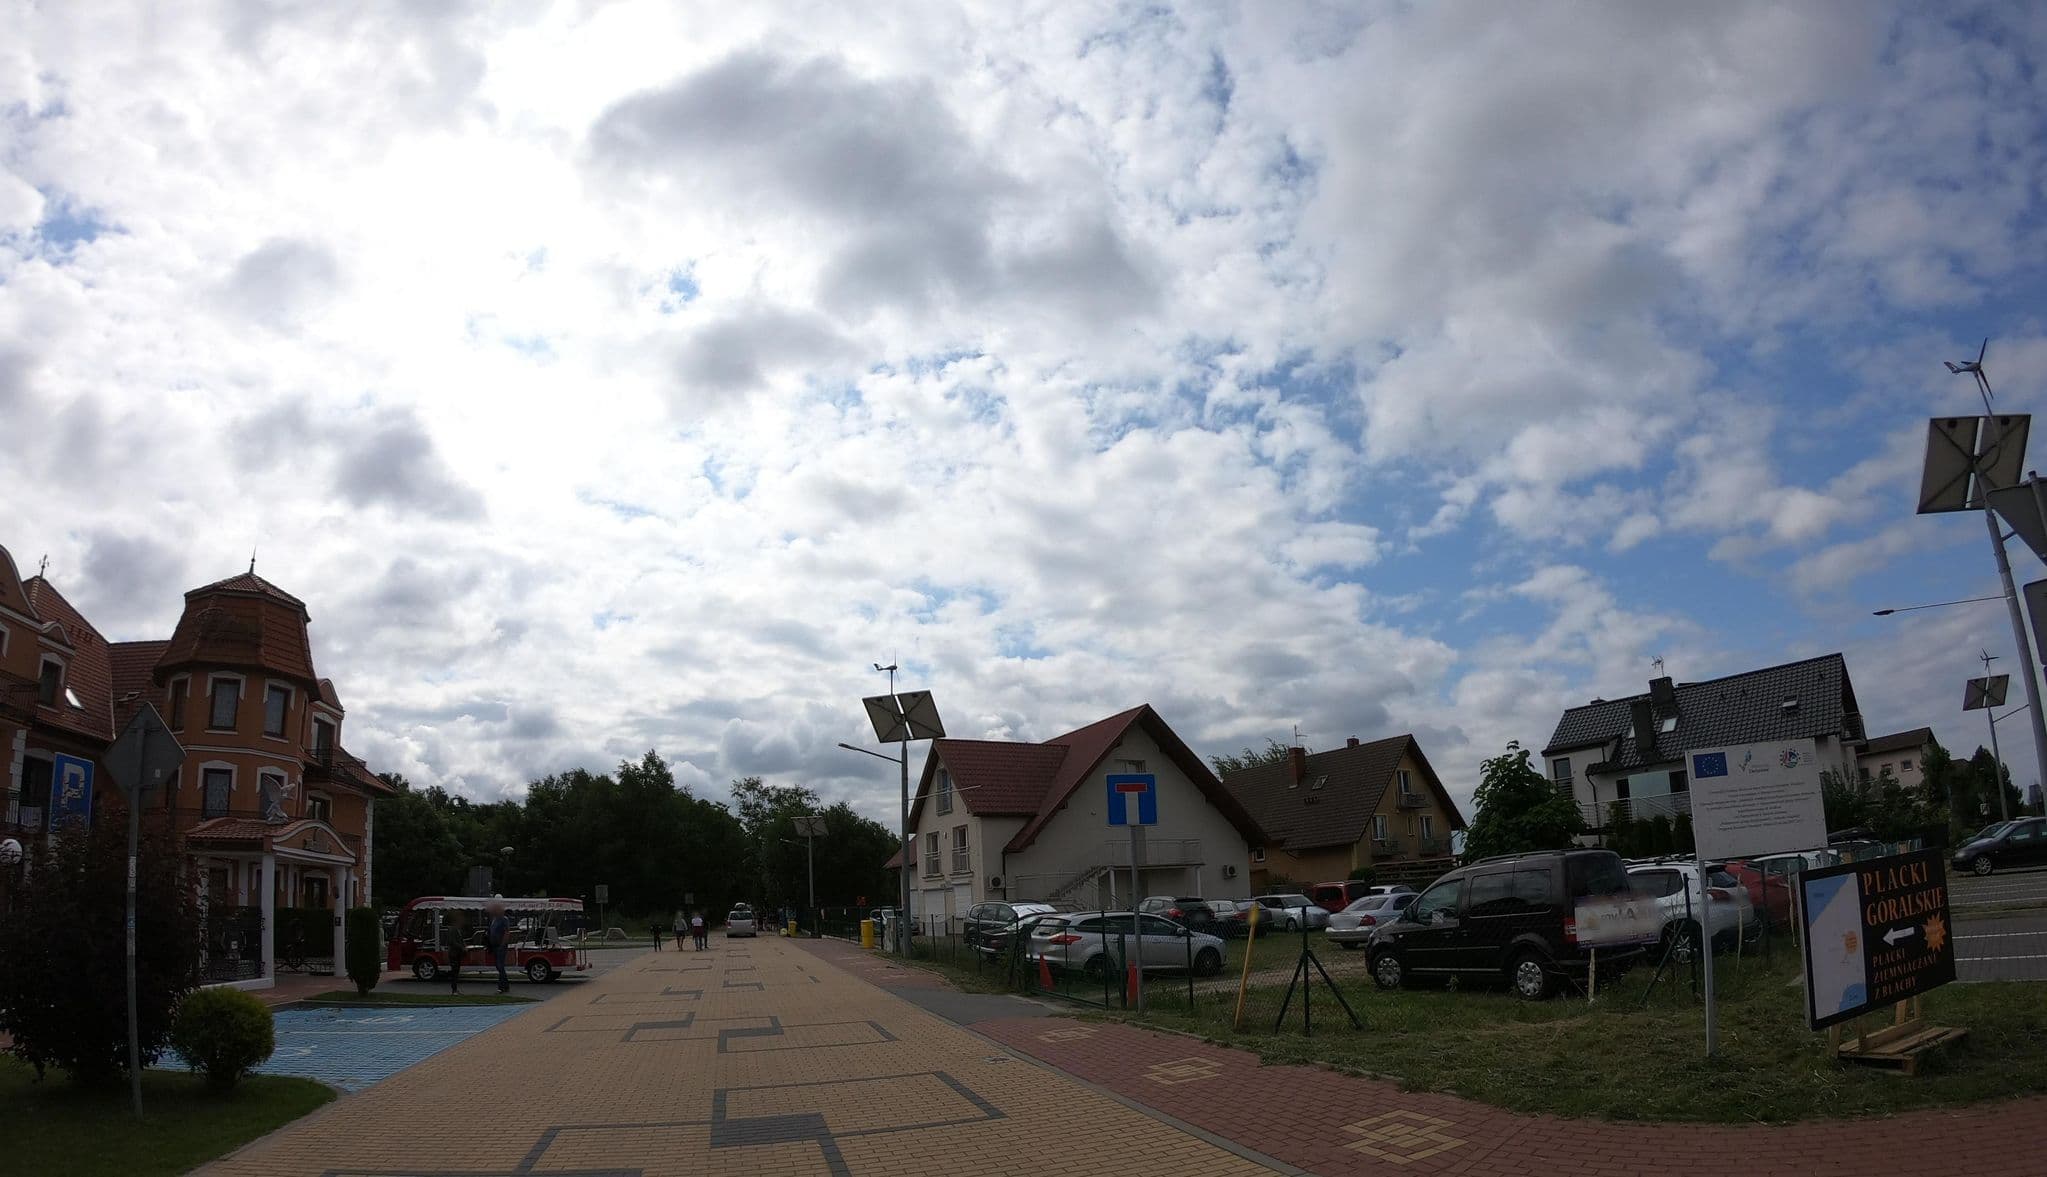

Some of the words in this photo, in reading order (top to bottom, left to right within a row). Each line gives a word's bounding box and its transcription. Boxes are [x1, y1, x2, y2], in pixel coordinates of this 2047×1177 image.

[1862, 861, 1928, 896] PLACKI
[1872, 947, 1905, 968] PLACKI
[1882, 975, 1916, 998] BLACHY
